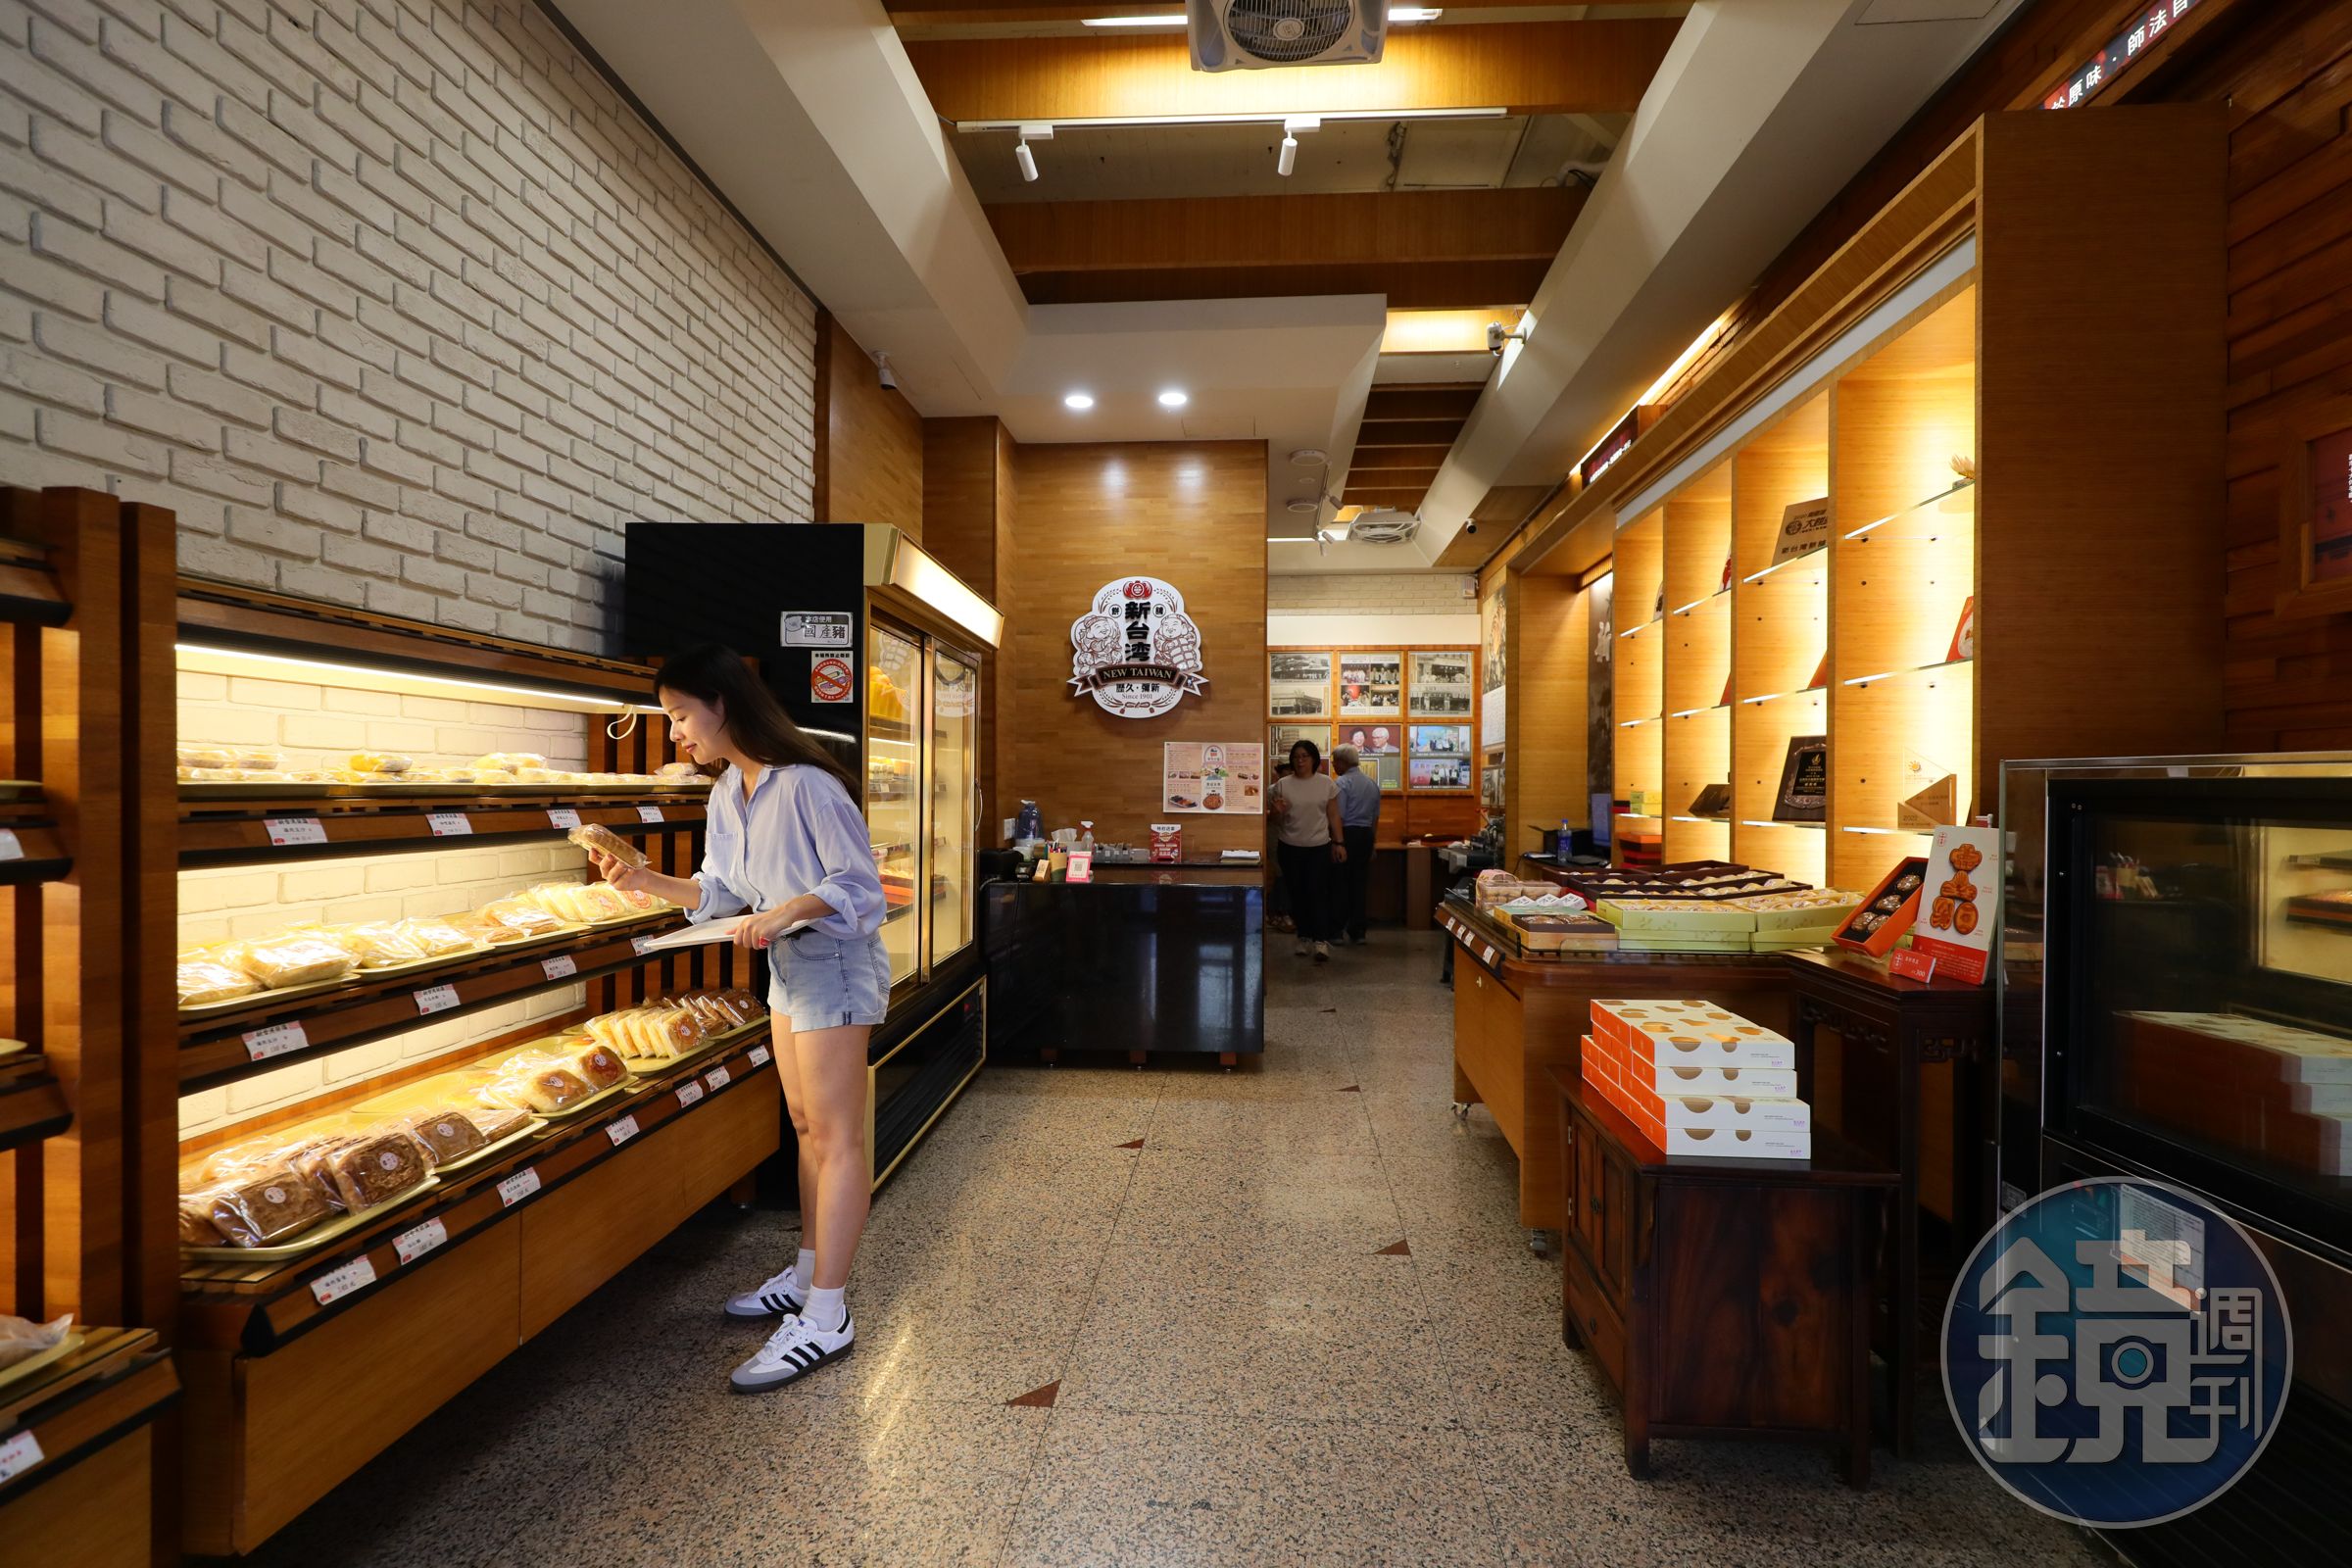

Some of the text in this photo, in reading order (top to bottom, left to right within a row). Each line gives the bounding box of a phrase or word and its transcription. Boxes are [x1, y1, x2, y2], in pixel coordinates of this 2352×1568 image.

[805, 624, 846, 639] 國產豬
[1103, 667, 1172, 679] NEW TAIWAN
